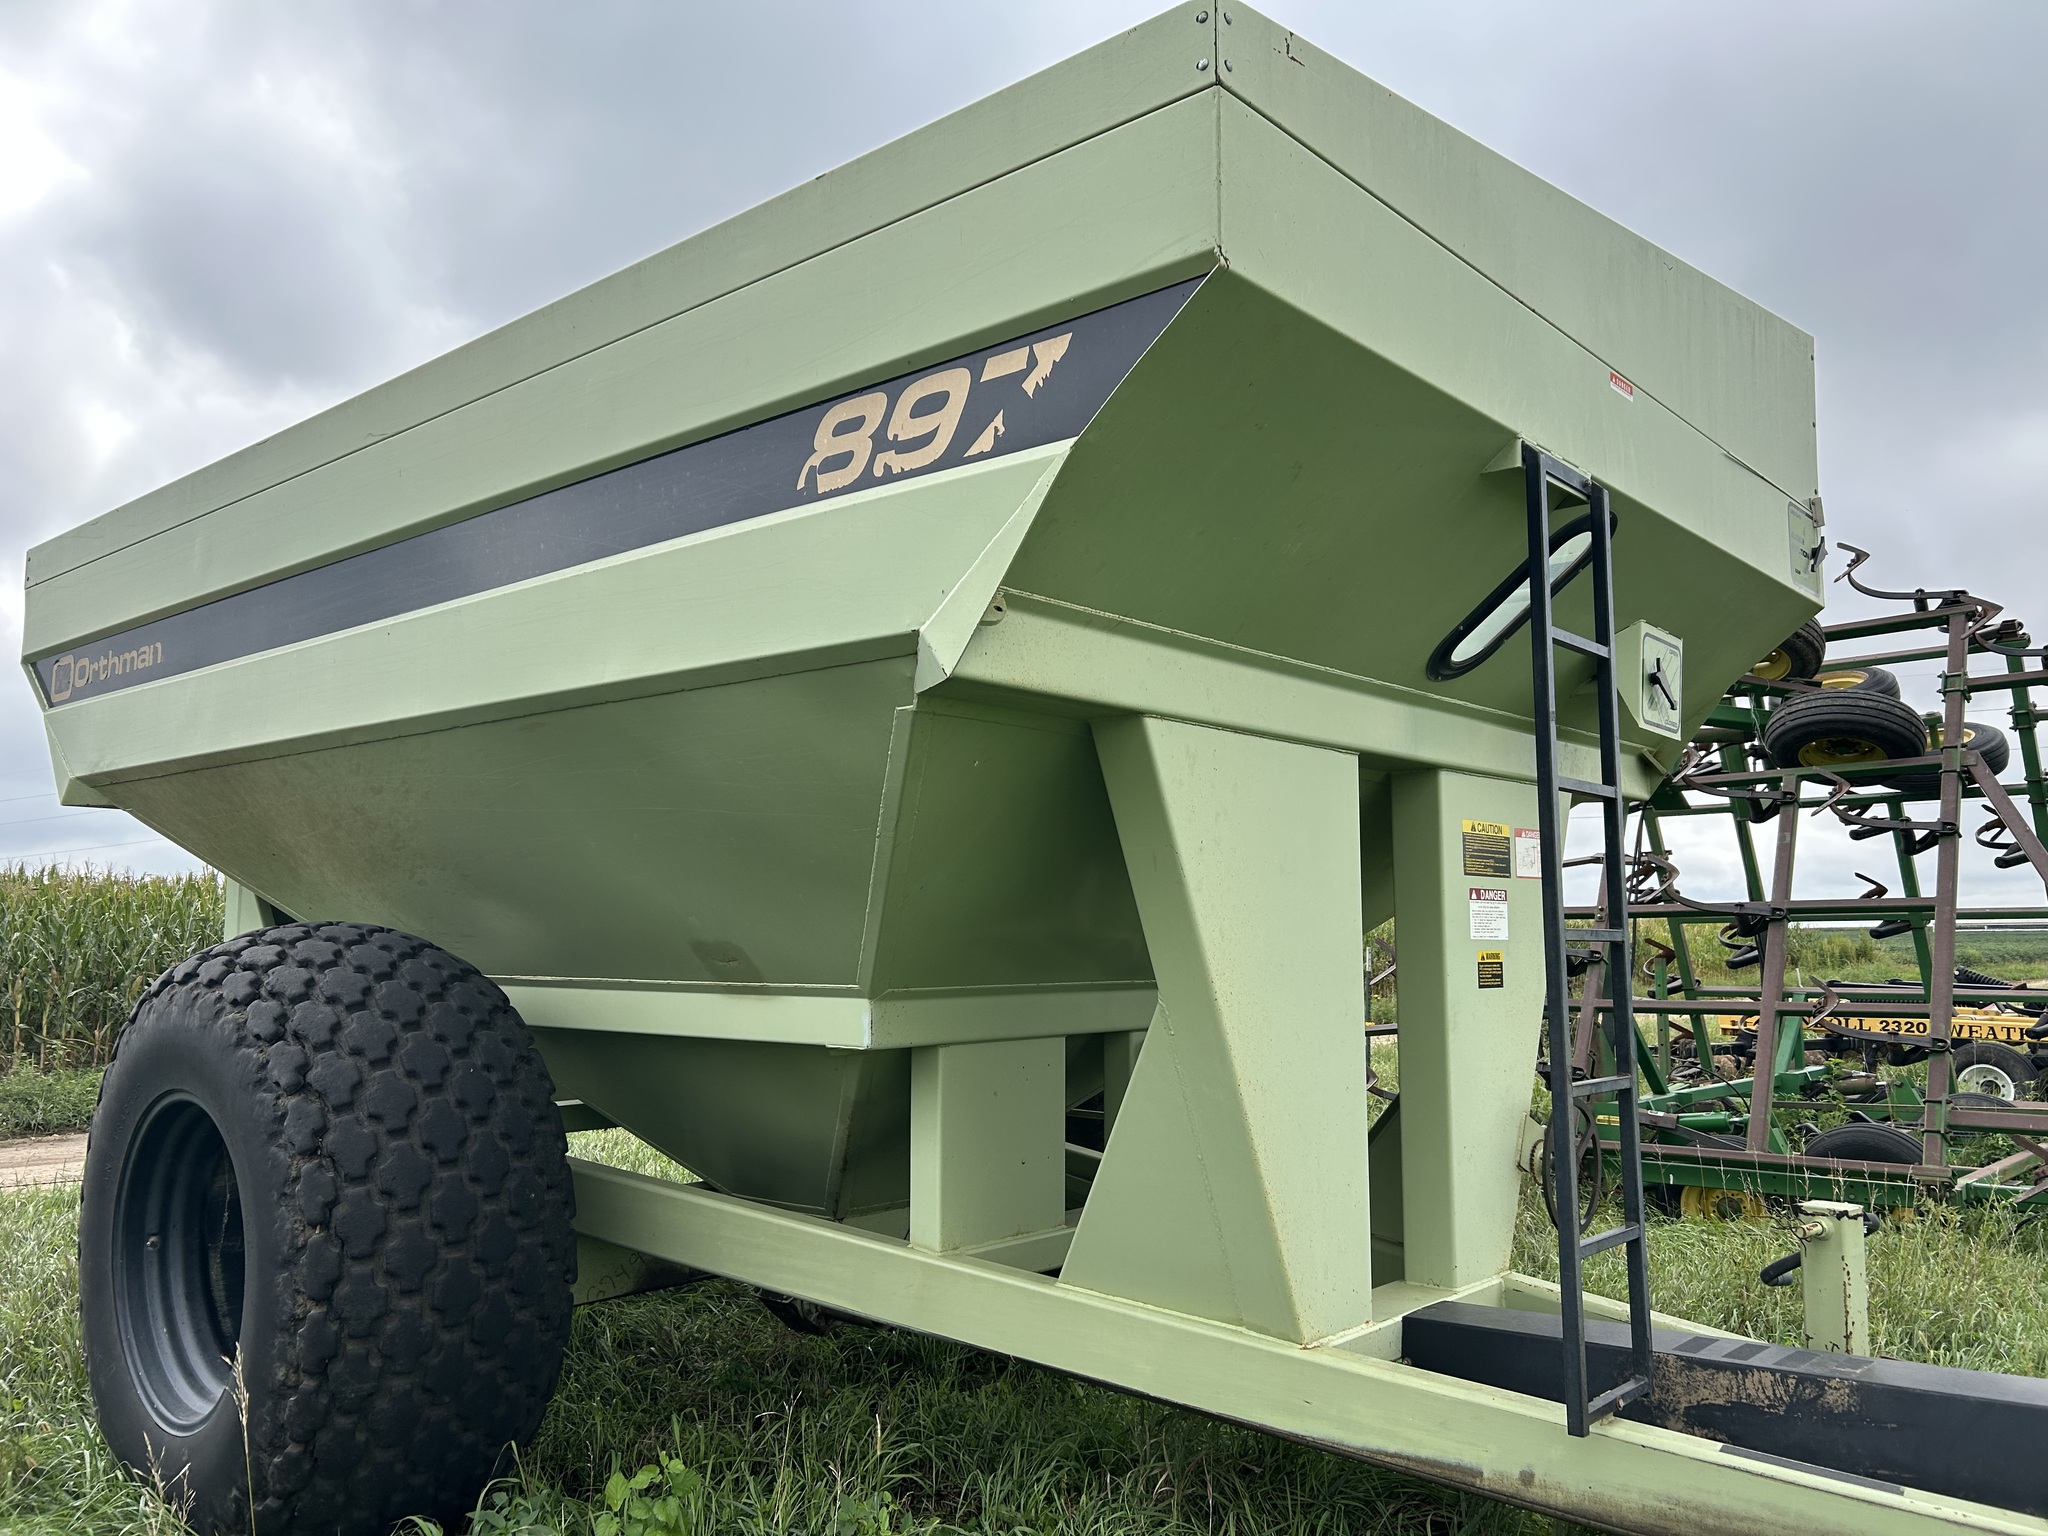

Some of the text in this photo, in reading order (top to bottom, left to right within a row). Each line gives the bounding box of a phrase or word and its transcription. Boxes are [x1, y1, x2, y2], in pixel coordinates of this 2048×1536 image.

[796, 332, 1073, 494] 897
[74, 641, 163, 688] Orthman
[1477, 822, 1503, 835] CAUTION
[1526, 830, 1541, 839] DANGE
[1480, 889, 1506, 901] DANGER
[1879, 1019, 1928, 1034] 2320
